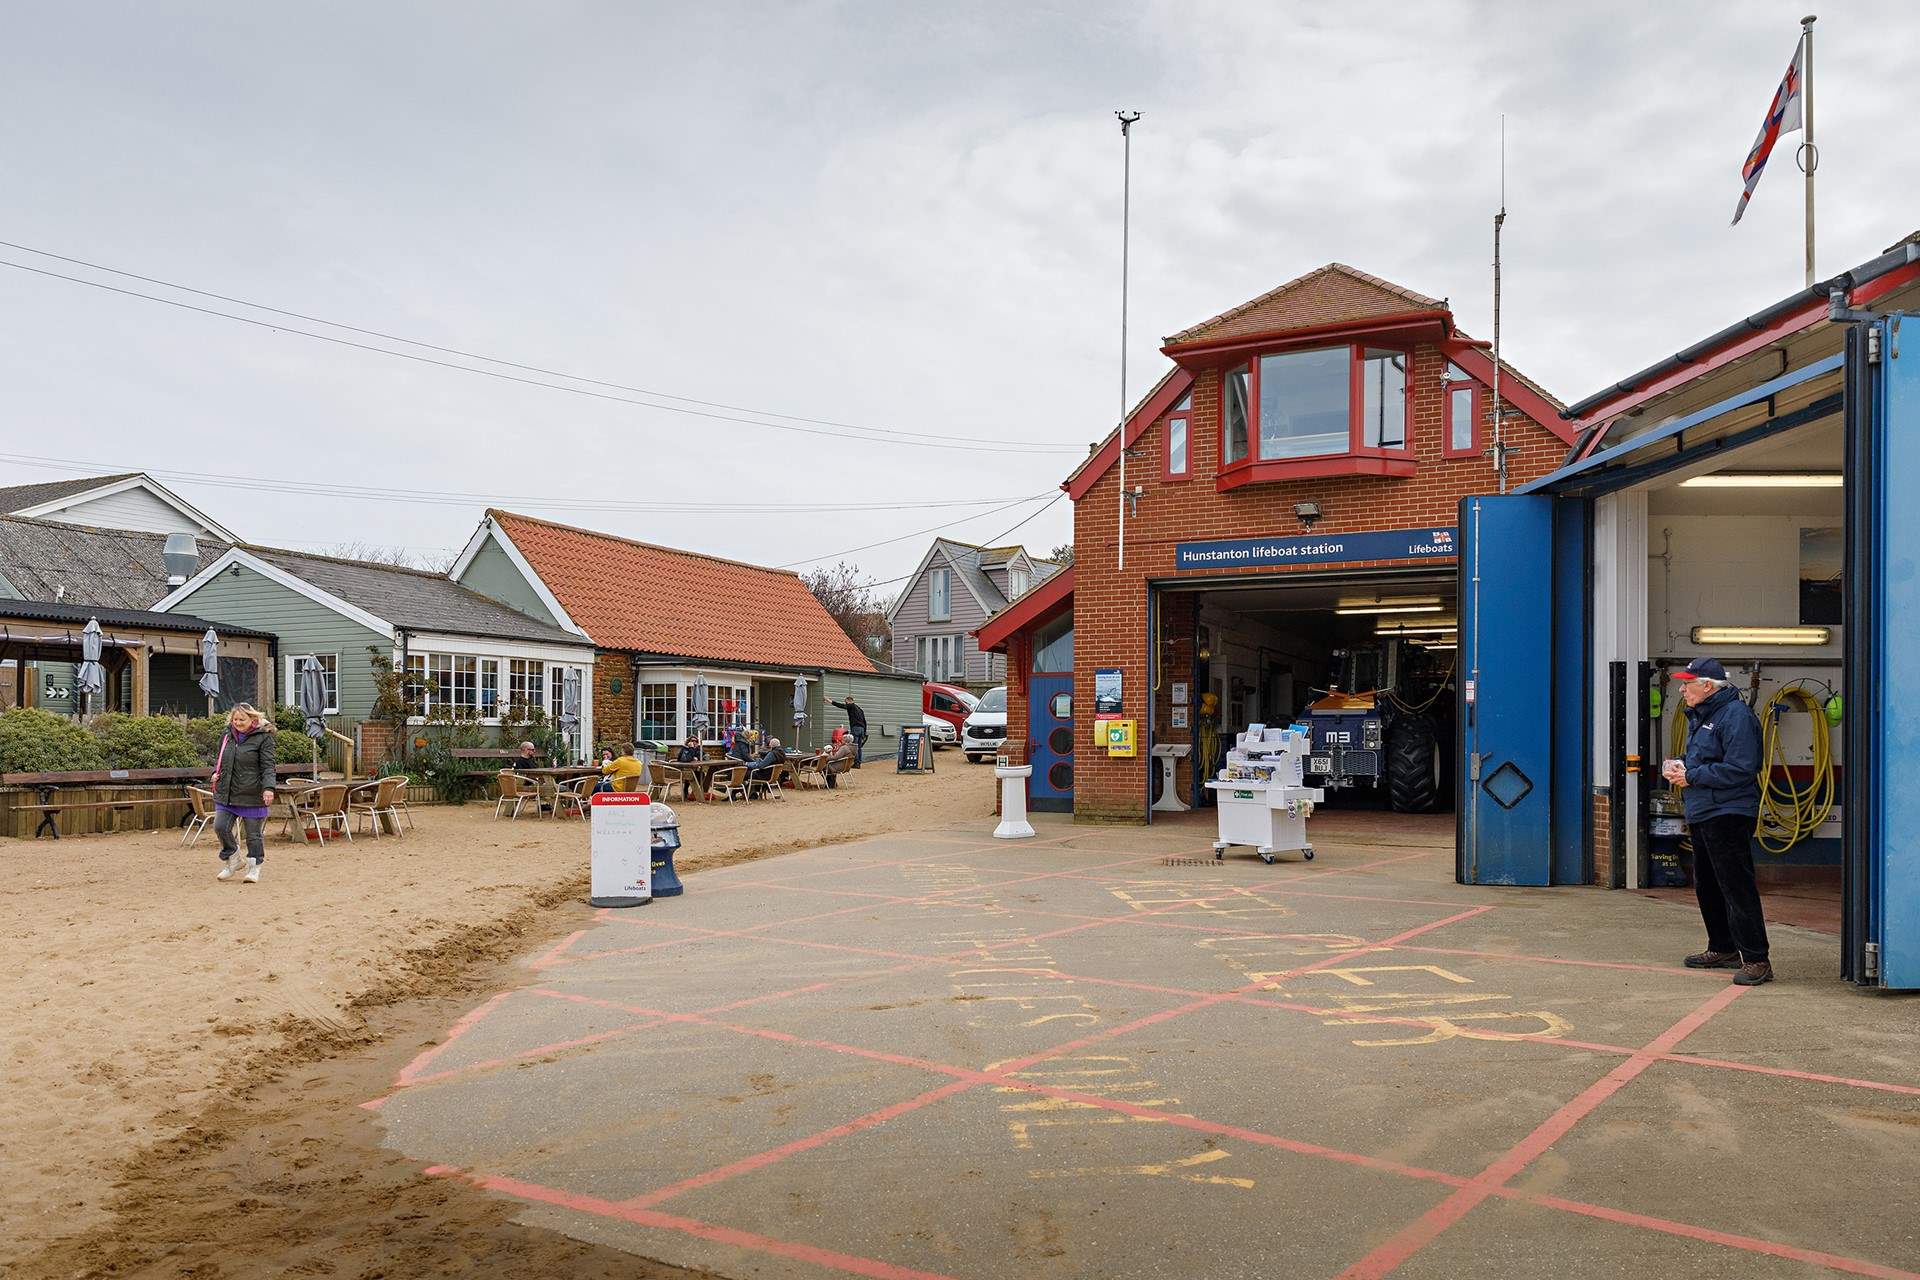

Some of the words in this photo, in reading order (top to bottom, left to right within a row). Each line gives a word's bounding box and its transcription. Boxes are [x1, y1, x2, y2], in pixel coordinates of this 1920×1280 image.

[1183, 548, 1249, 563] Hunstanton
[1252, 545, 1298, 559] lifeboat
[1301, 542, 1344, 556] station
[1408, 543, 1454, 556] Lifeboats
[1195, 933, 1573, 1047] CLEAR
[983, 1055, 1256, 1189] ONLY
